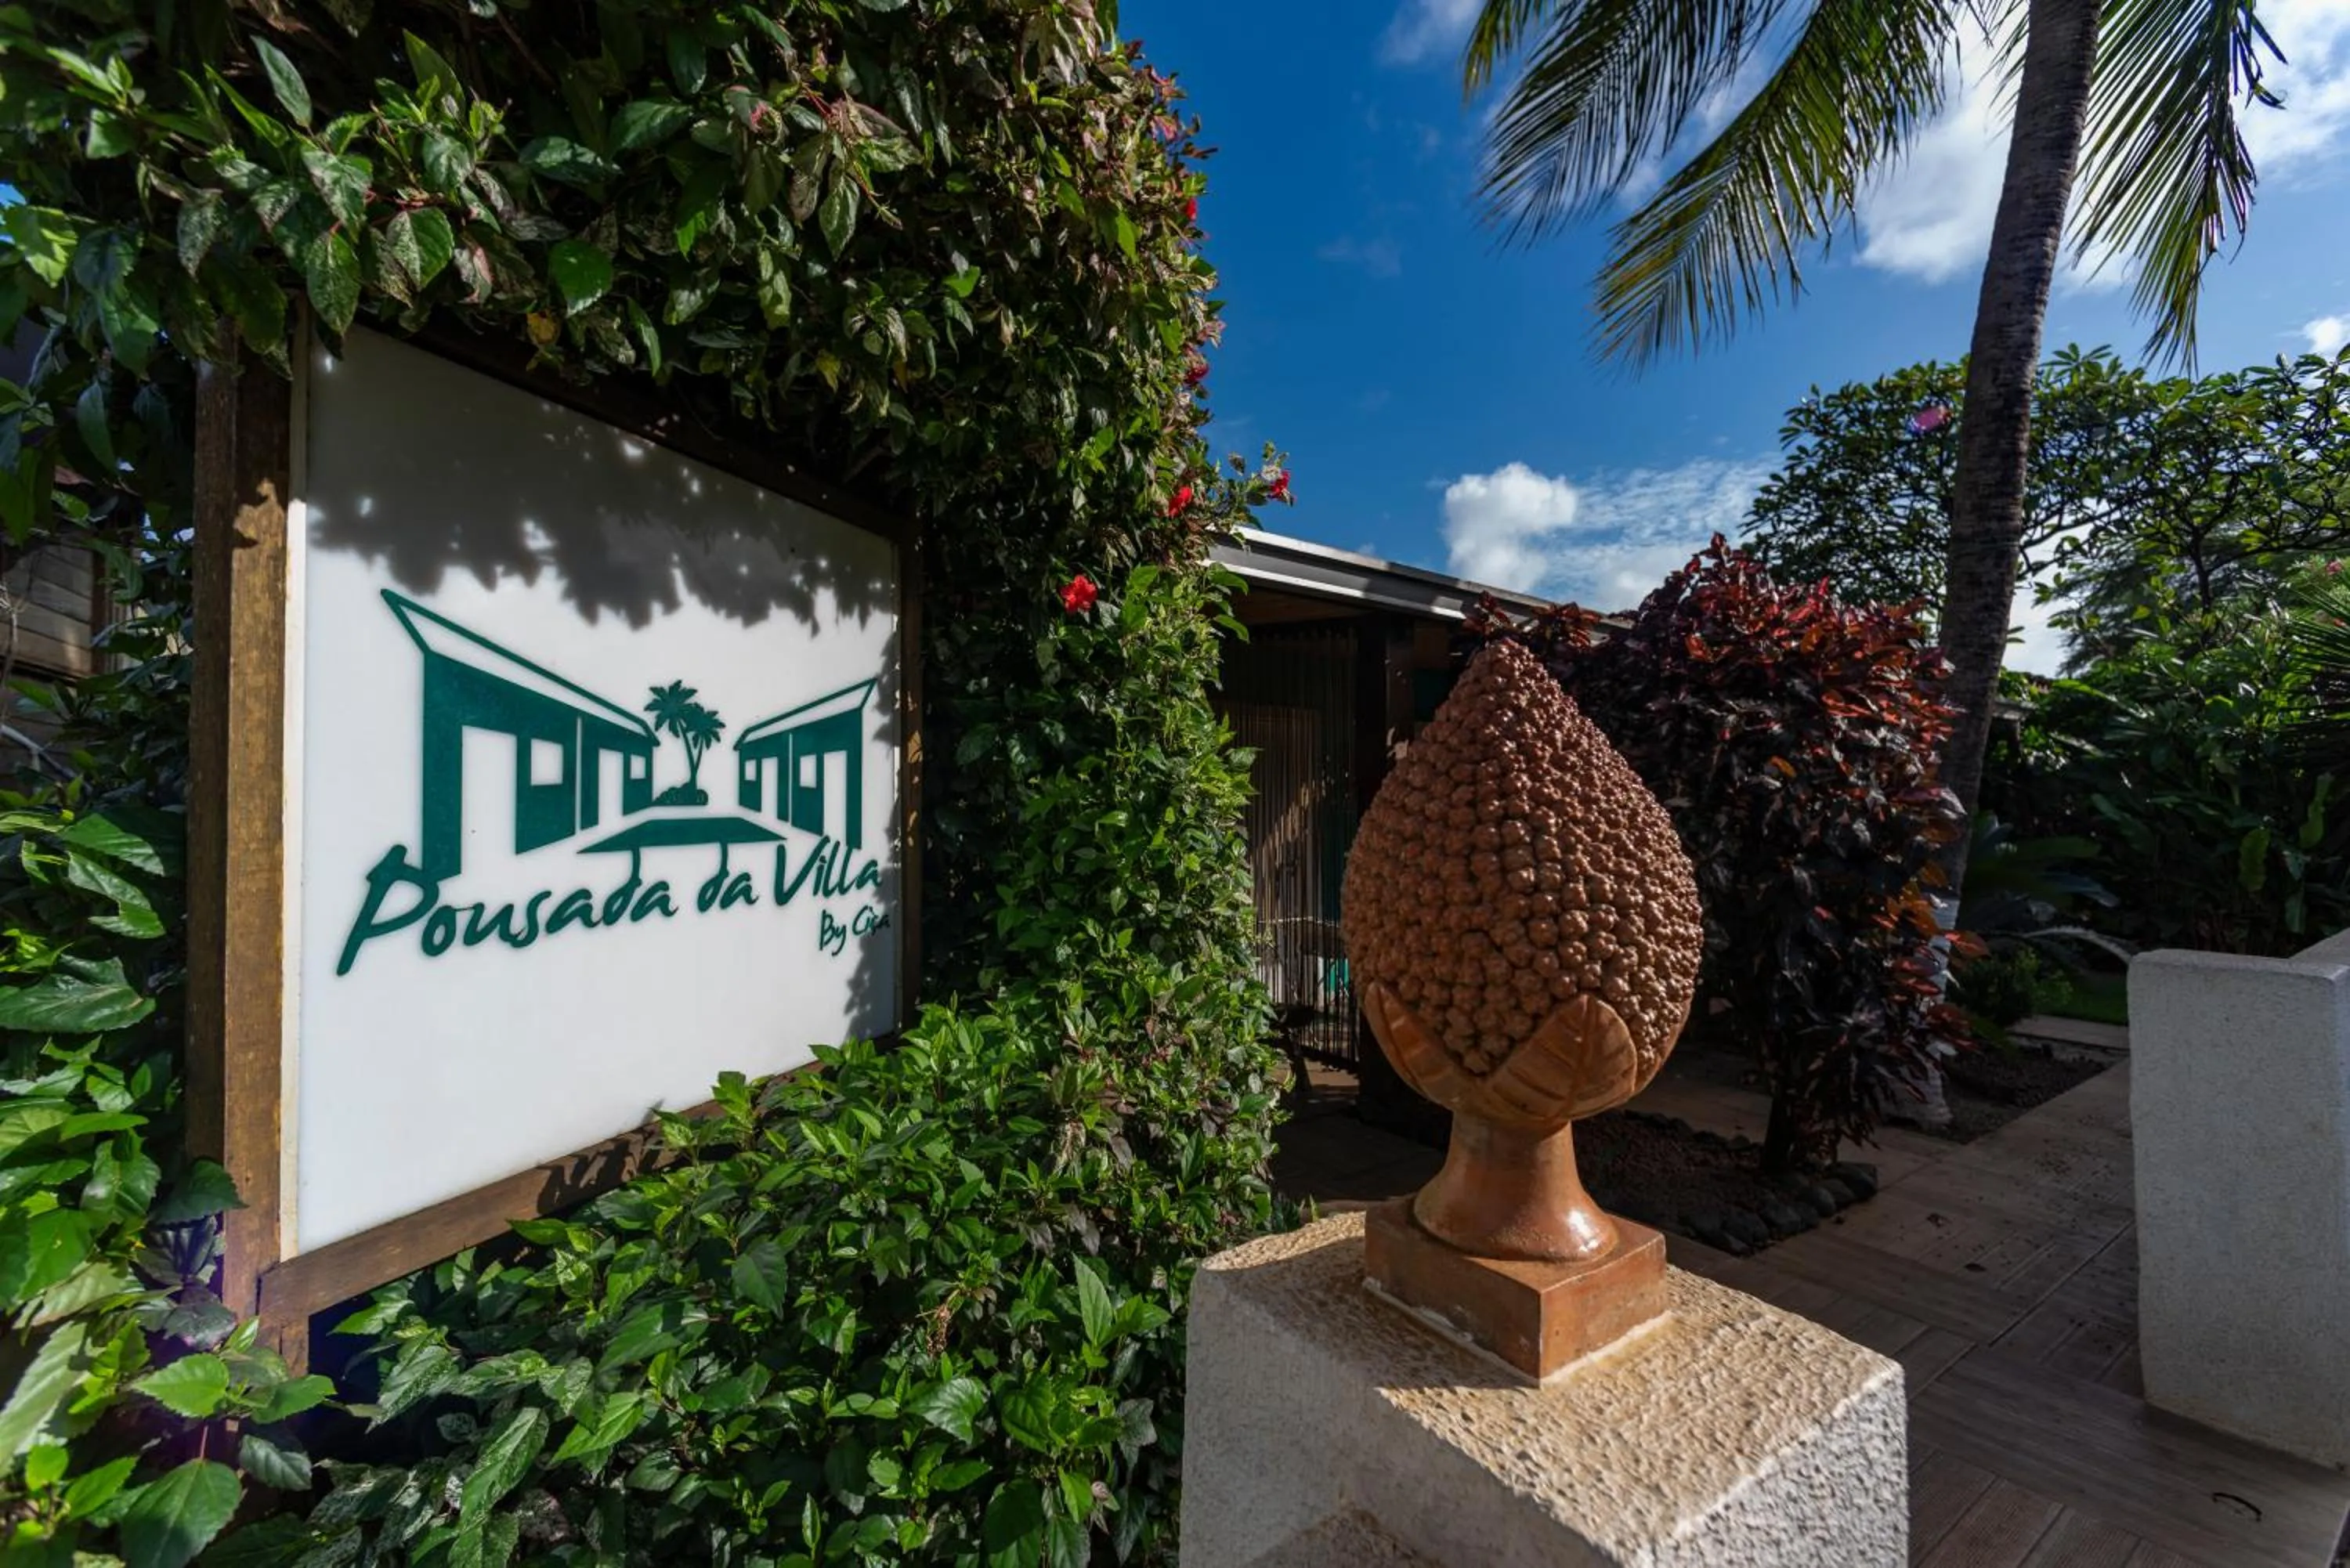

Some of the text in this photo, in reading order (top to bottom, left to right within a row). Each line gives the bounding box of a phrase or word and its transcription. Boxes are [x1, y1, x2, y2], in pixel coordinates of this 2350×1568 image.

[336, 835, 883, 977] Pousada da Villa
[819, 909, 847, 957] By
